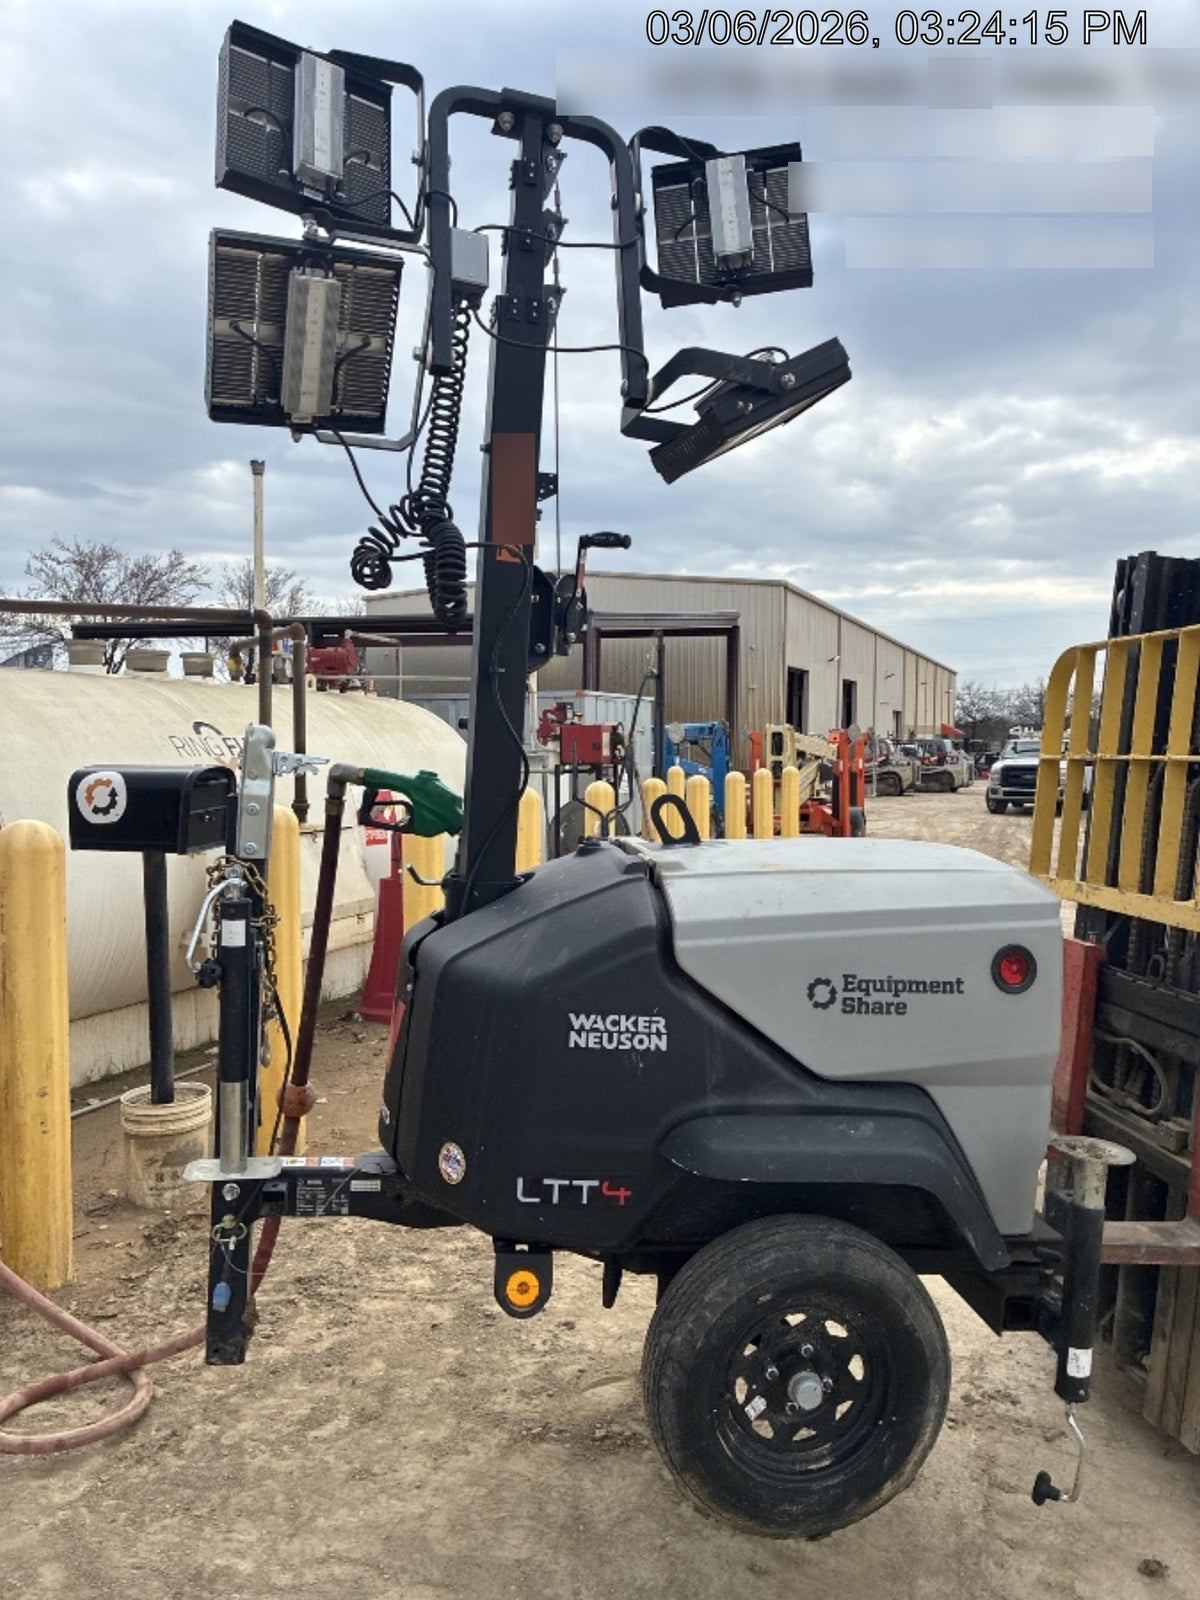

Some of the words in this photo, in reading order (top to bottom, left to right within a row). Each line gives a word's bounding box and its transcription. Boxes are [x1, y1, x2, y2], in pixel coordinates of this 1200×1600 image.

[168, 735, 225, 757] RING
[842, 973, 964, 998] Equipment
[841, 997, 908, 1015] Share
[568, 1013, 668, 1033] WACKER
[568, 1031, 668, 1051] NEUSON
[517, 1177, 632, 1206] LTT4
